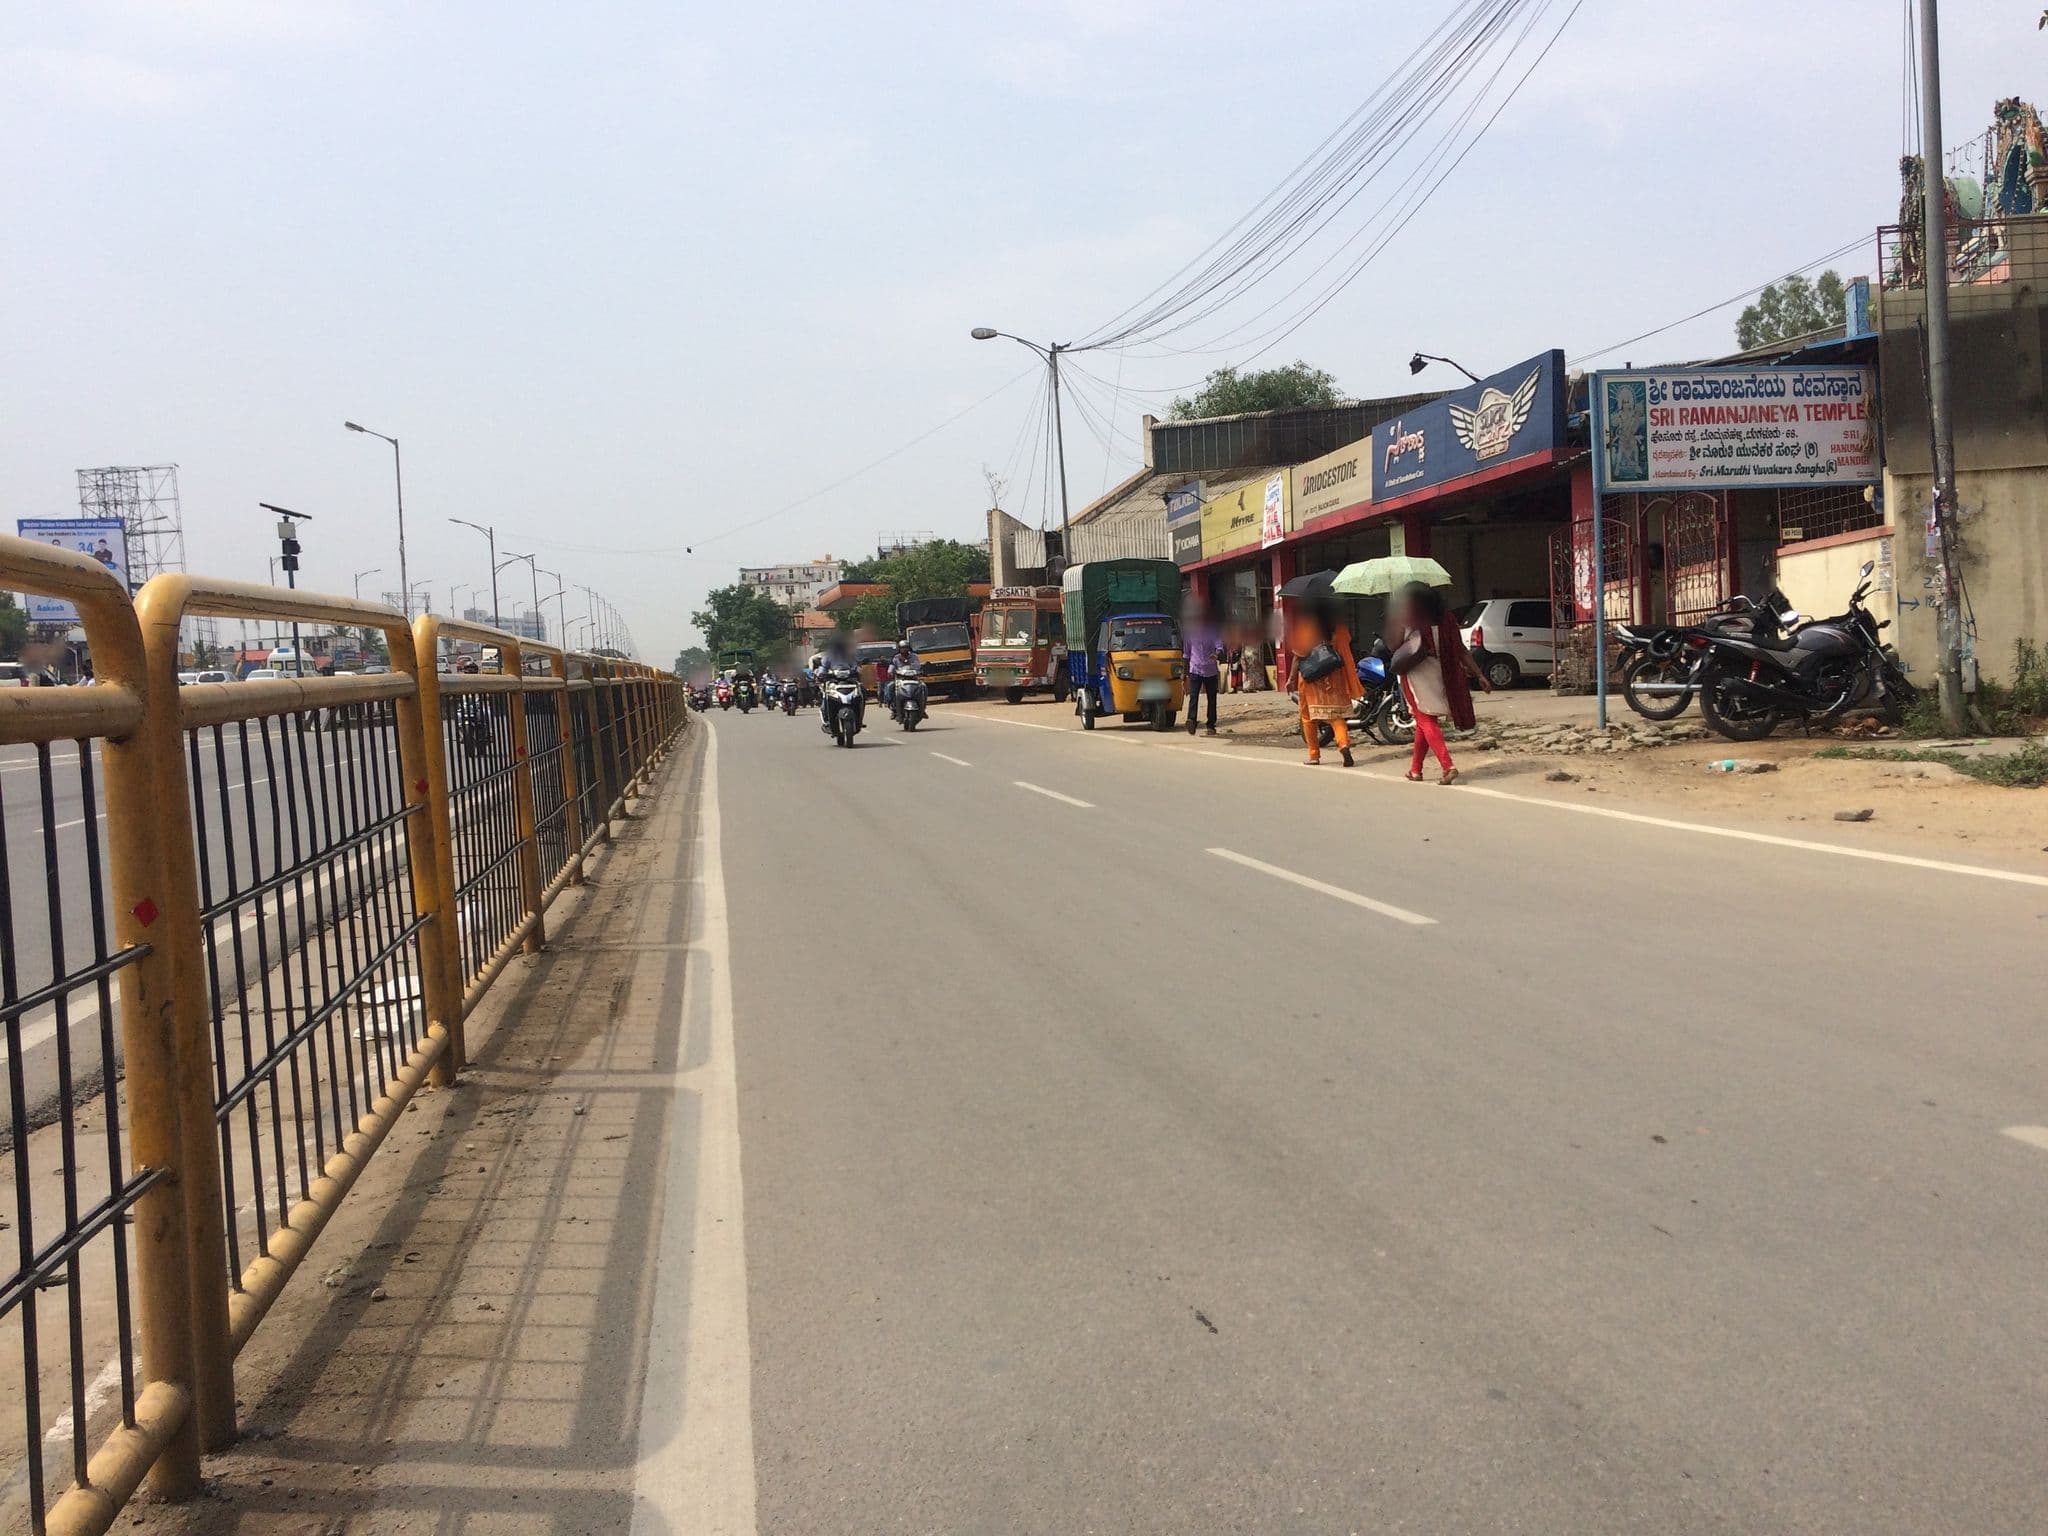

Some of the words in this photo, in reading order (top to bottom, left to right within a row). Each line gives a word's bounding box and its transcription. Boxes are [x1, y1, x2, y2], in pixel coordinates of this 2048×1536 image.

[1650, 407, 1675, 427] SRI
[1679, 404, 1799, 426] RAMANJANEYA
[1803, 402, 1867, 422] TEMPLE
[1843, 430, 1859, 439] SRI
[1303, 458, 1358, 497] BRIDGESTONE
[1752, 464, 1793, 476] Yuvakara
